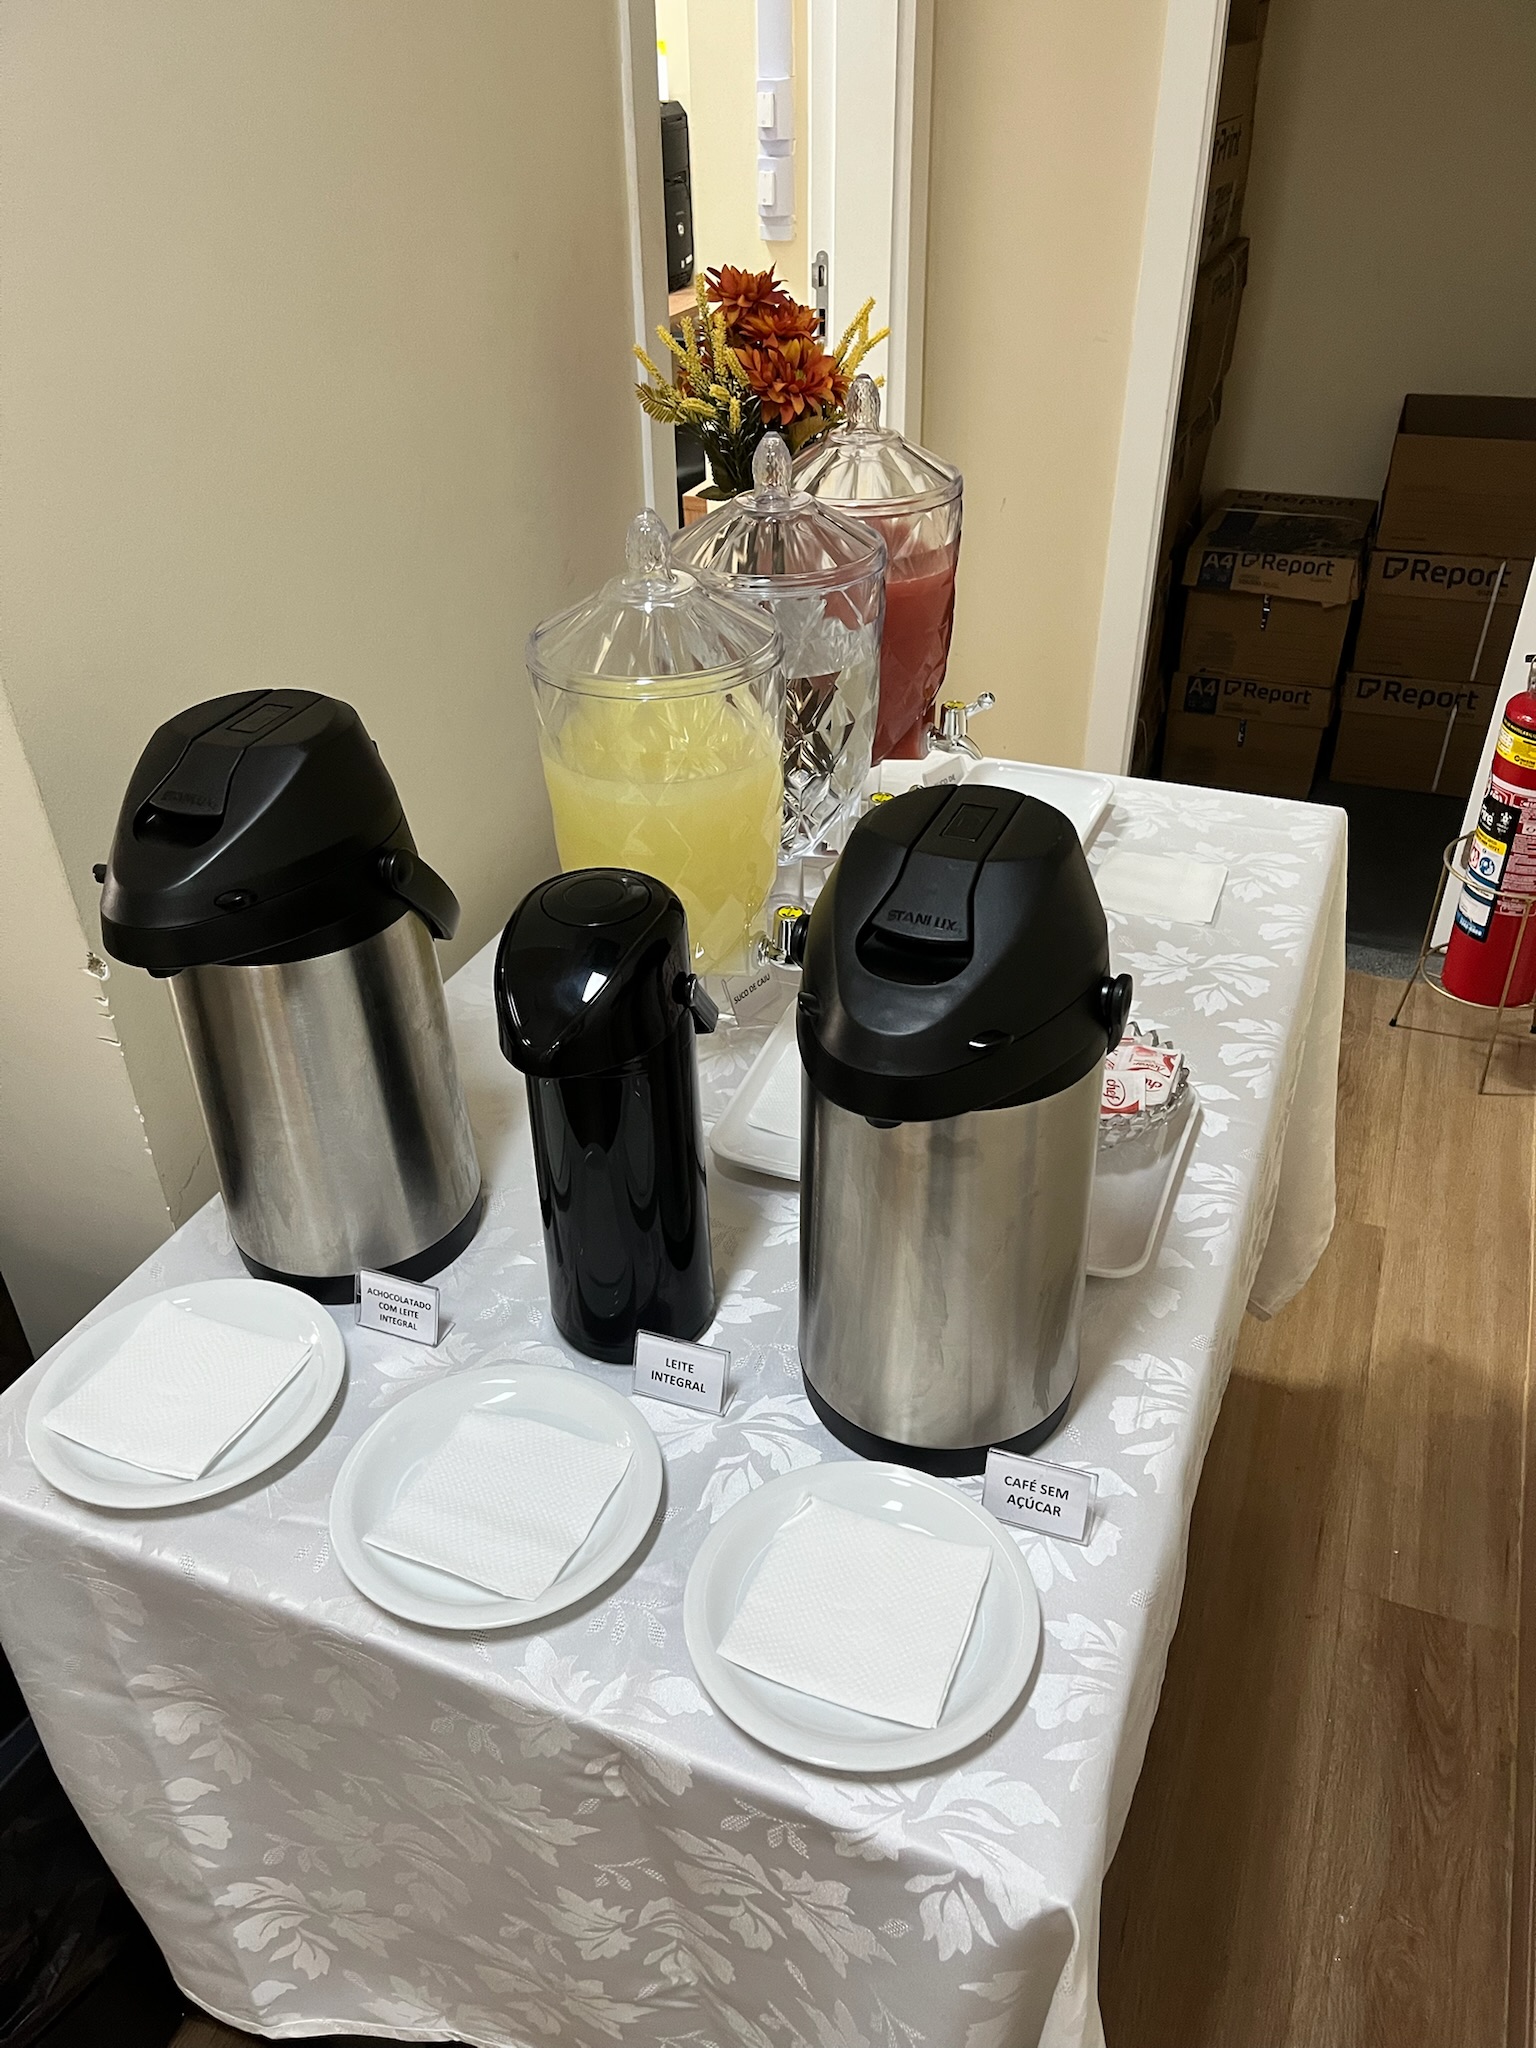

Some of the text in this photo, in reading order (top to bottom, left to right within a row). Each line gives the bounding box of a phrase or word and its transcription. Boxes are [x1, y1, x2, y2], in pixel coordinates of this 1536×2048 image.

[1203, 553, 1336, 576] A4 Report
[1409, 558, 1512, 589] Report
[1187, 679, 1312, 705] A4 Report
[1382, 681, 1479, 710] Report
[887, 909, 958, 931] STANLUX
[733, 974, 771, 1005] SUCO DE CAJU
[1103, 1079, 1121, 1100] chef
[366, 1287, 432, 1311] ACHOCOLATADO
[378, 1301, 420, 1320] COM LEITE
[378, 1313, 418, 1331] INTEGRAL
[665, 1357, 695, 1375] LEITE
[650, 1370, 707, 1395] INTEGRAL
[1003, 1475, 1070, 1501] CAFÉ SEM
[1006, 1494, 1062, 1517] AÇÚCAR
